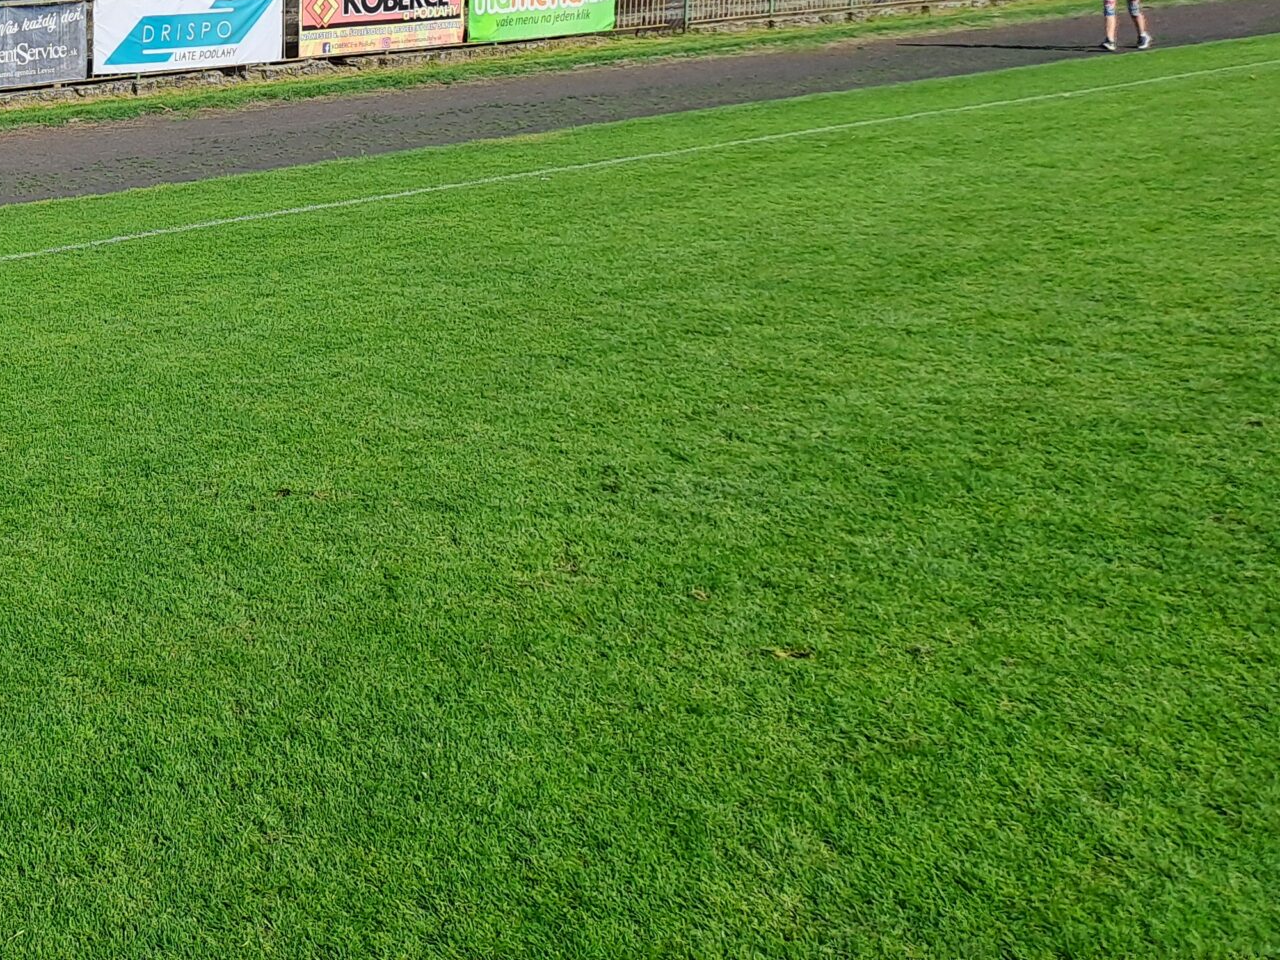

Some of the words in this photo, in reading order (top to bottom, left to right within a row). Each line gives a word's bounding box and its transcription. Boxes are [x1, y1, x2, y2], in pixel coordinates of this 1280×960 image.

[413, 5, 458, 19] PODLAHY
[496, 17, 513, 27] vaše
[515, 15, 539, 26] menu
[541, 14, 551, 24] na
[552, 10, 575, 25] jeden
[576, 9, 591, 19] klik
[22, 12, 57, 32] každý
[142, 20, 233, 43] DRISPO
[174, 50, 197, 62] LIATE
[199, 47, 238, 60] PODLAHY
